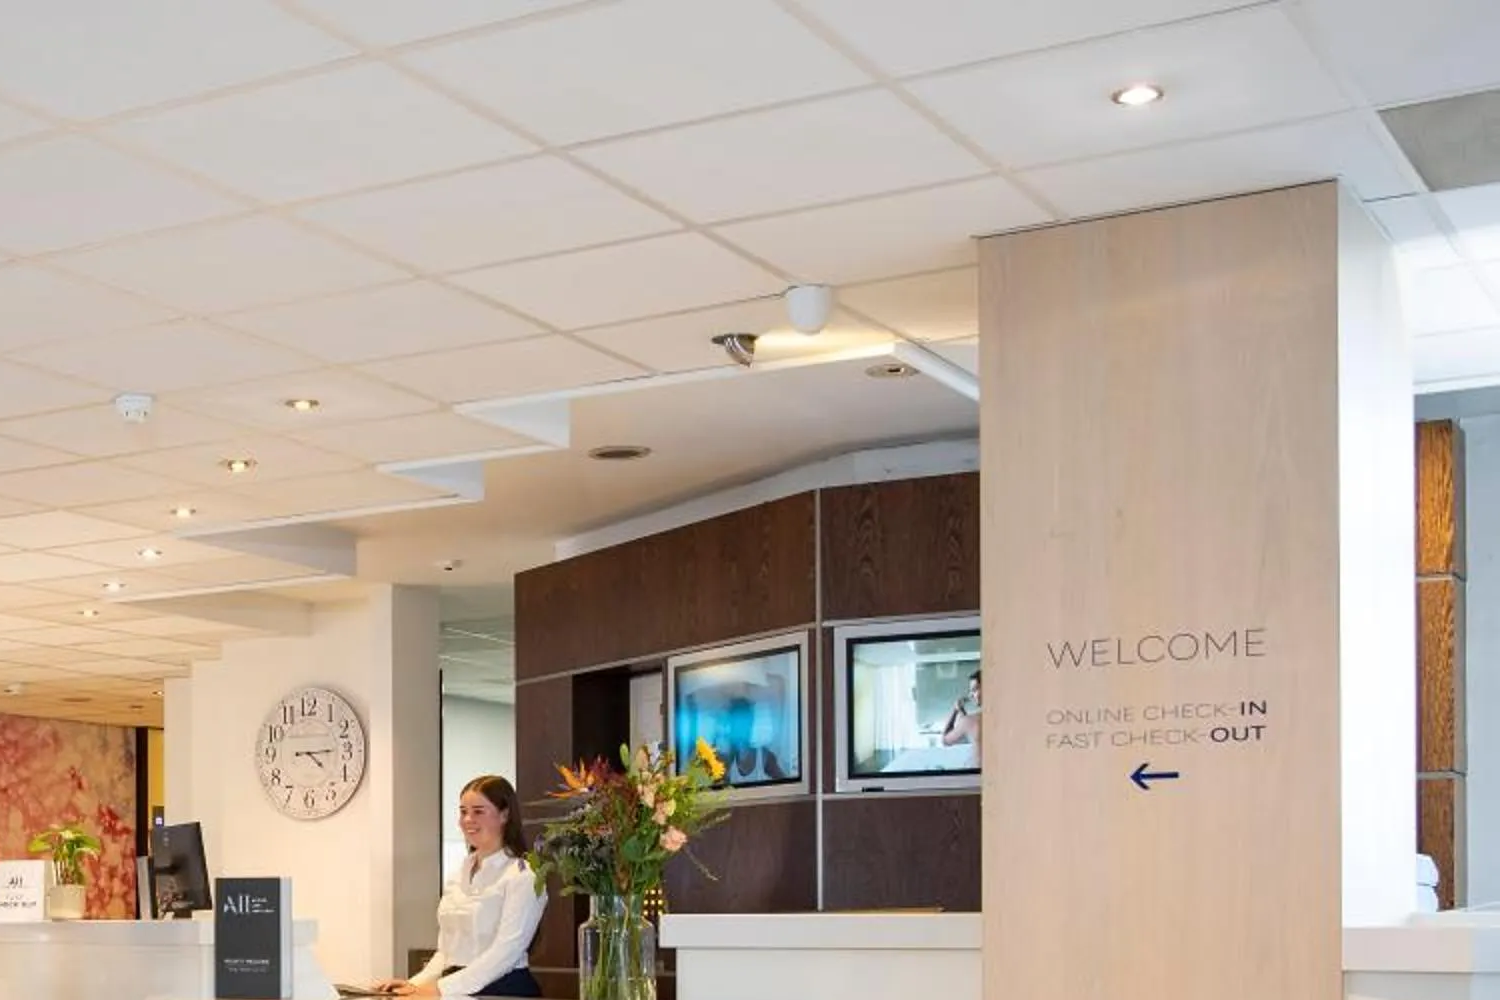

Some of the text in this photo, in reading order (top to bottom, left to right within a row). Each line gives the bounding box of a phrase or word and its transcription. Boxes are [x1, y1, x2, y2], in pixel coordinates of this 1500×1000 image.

[1047, 628, 1267, 669] WELCOME
[282, 703, 295, 725] 11
[300, 697, 317, 717] 12
[1046, 699, 1267, 726] ONLINE CHECK-IN
[267, 724, 285, 743] 10
[339, 719, 349, 739] 2
[1046, 724, 1267, 751] FAST CHECK-OUT
[265, 745, 276, 765] 9
[341, 740, 353, 761] 3
[271, 767, 281, 786] 8
[284, 784, 294, 808] 7
[303, 788, 316, 809] 6
